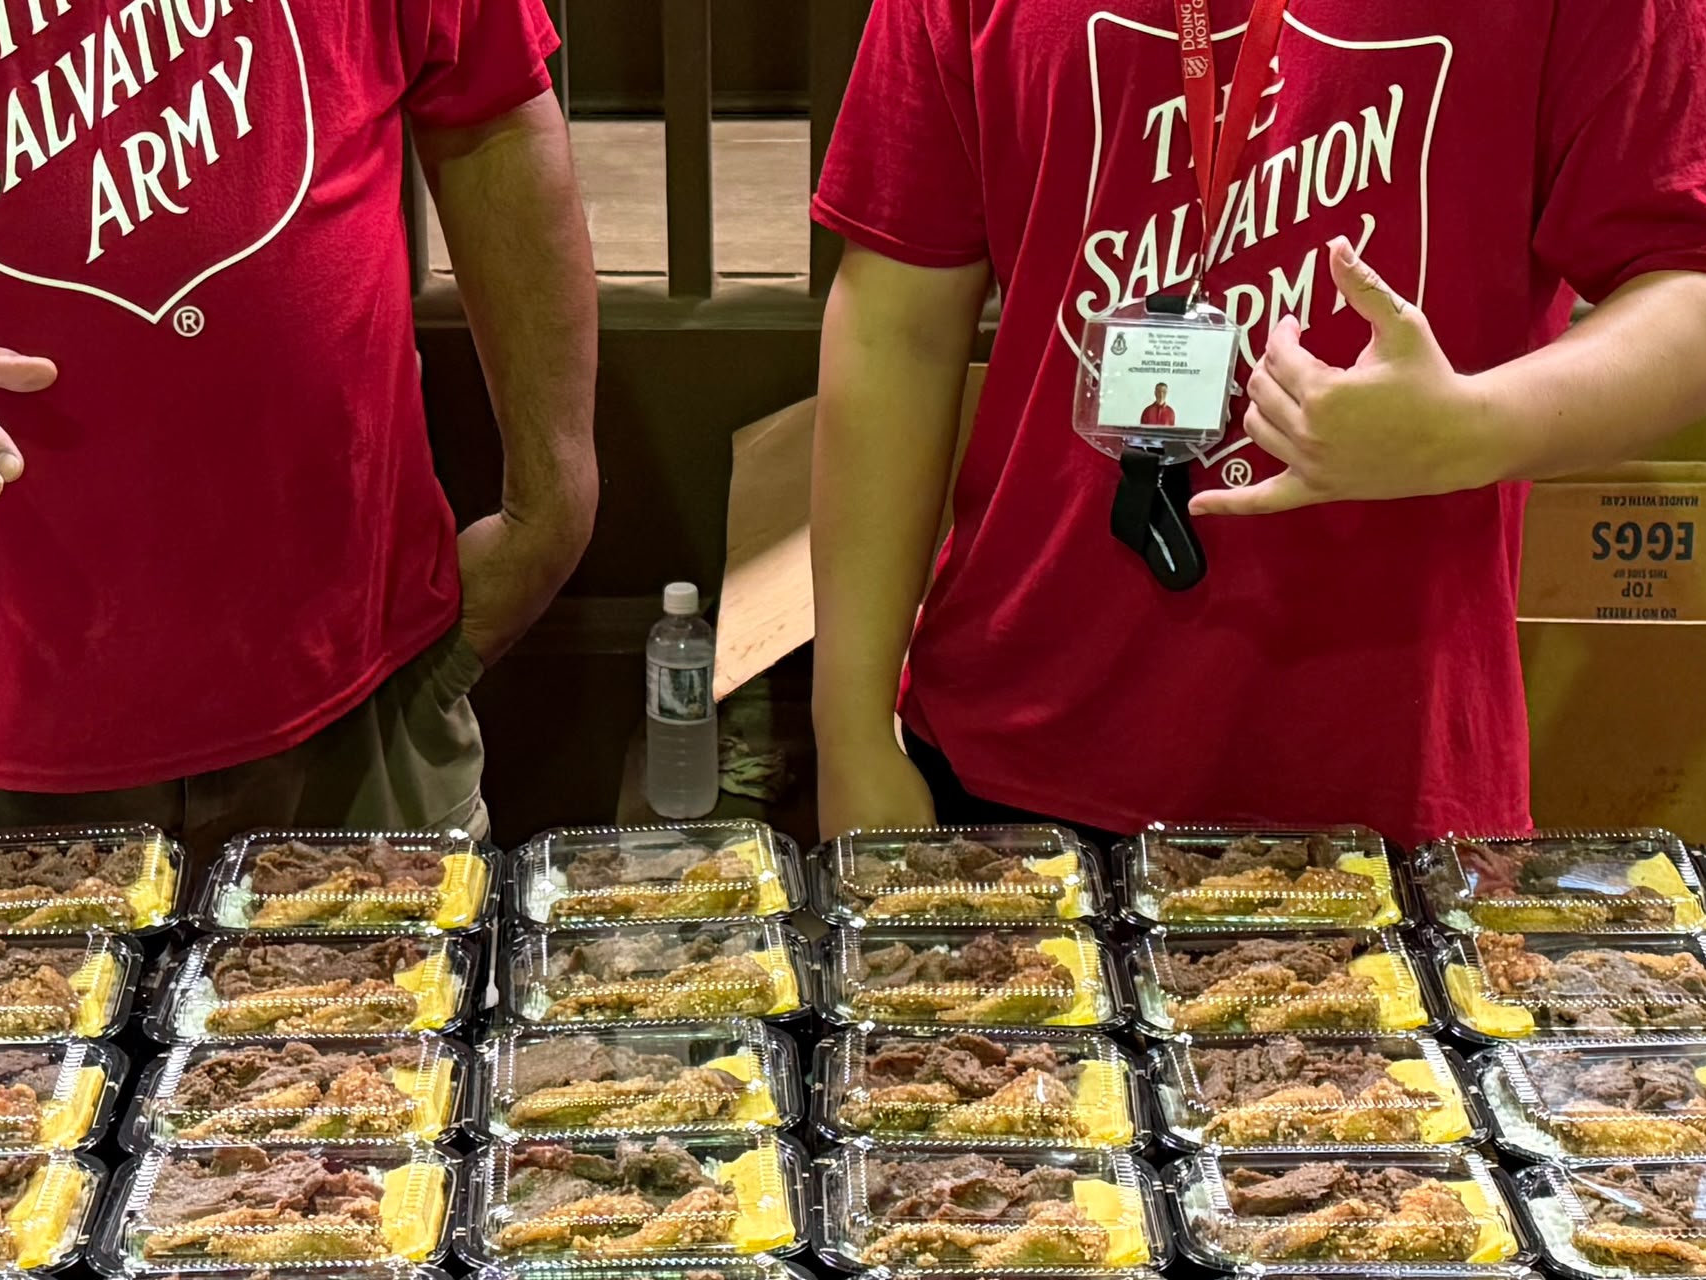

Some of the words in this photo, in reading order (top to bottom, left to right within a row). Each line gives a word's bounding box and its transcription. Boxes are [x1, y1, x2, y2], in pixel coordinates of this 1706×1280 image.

[1181, 4, 1195, 50] DOING
[1194, 12, 1208, 48] MOST
[1143, 55, 1286, 184] TE
[86, 36, 253, 264] ARMY
[1221, 213, 1376, 372] RMY
[1591, 521, 1694, 561] EGGS
[1621, 581, 1653, 598] TOP
